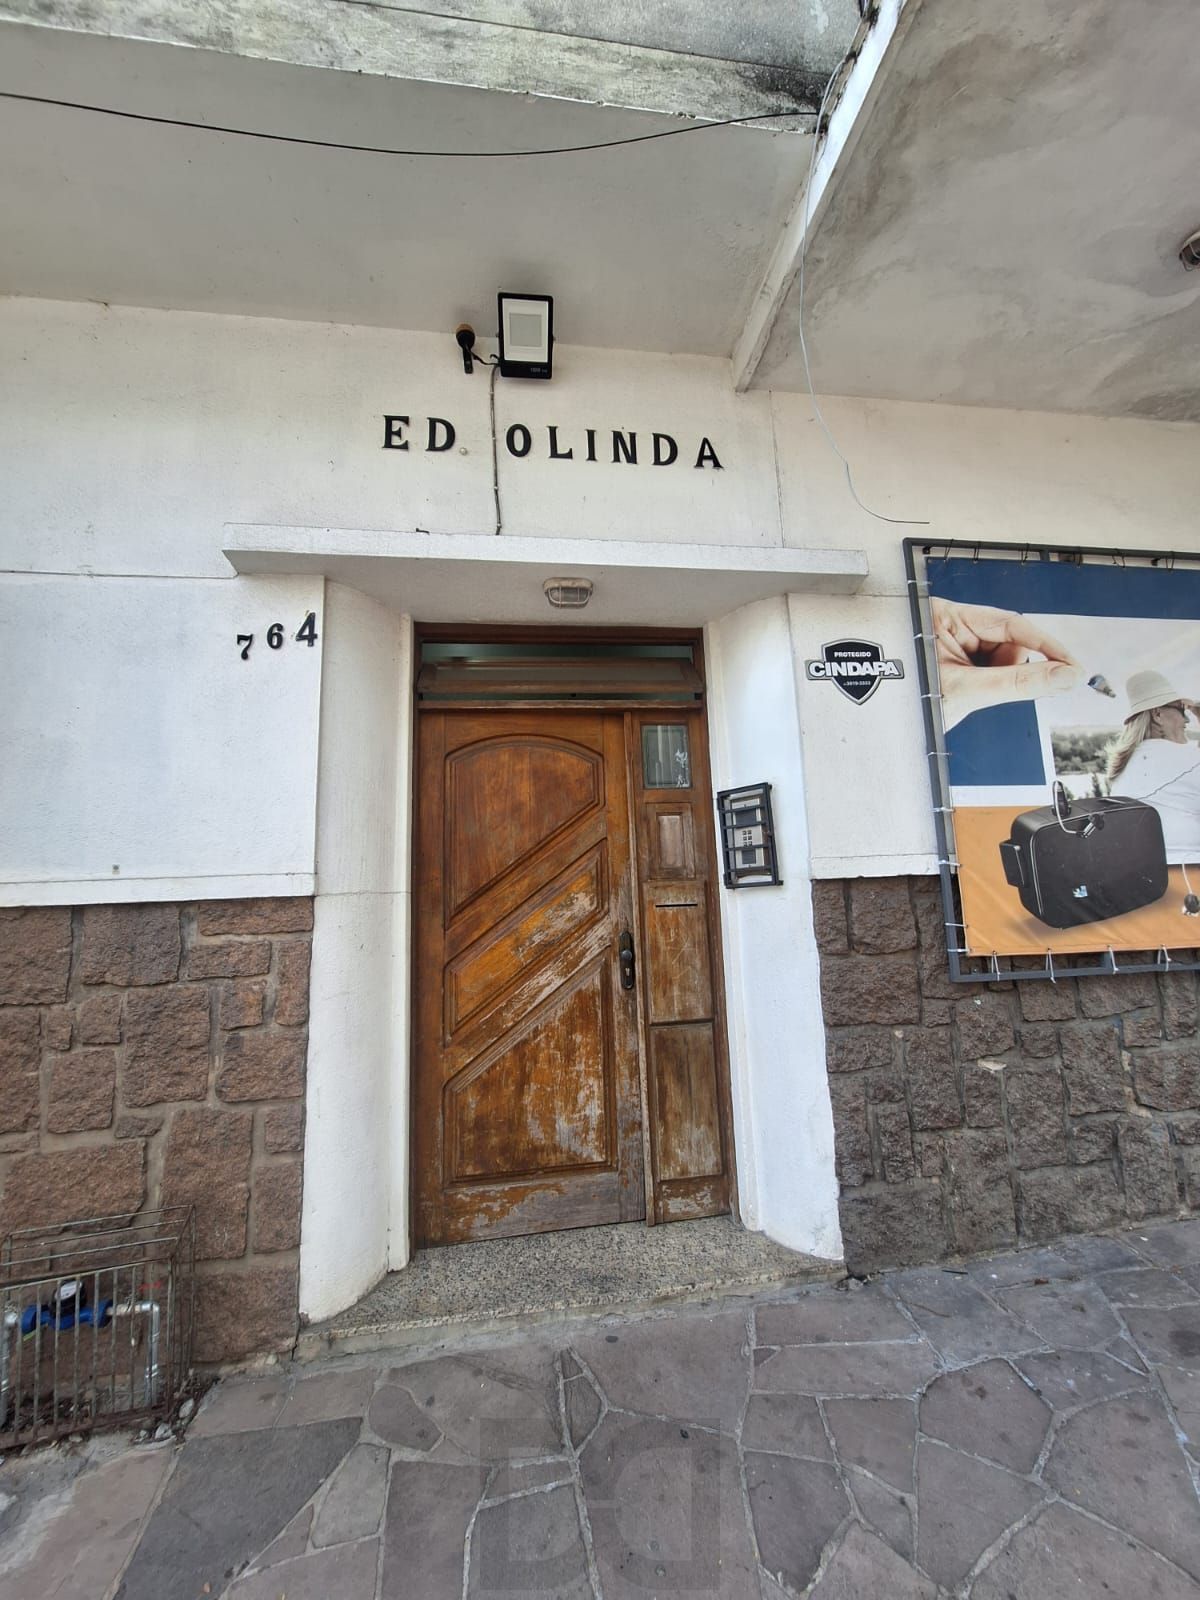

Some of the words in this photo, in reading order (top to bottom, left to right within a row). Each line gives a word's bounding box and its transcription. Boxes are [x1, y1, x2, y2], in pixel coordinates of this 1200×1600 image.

[505, 423, 724, 469] OLINDA
[236, 611, 318, 660] 764
[809, 661, 899, 676] CINDAPA
